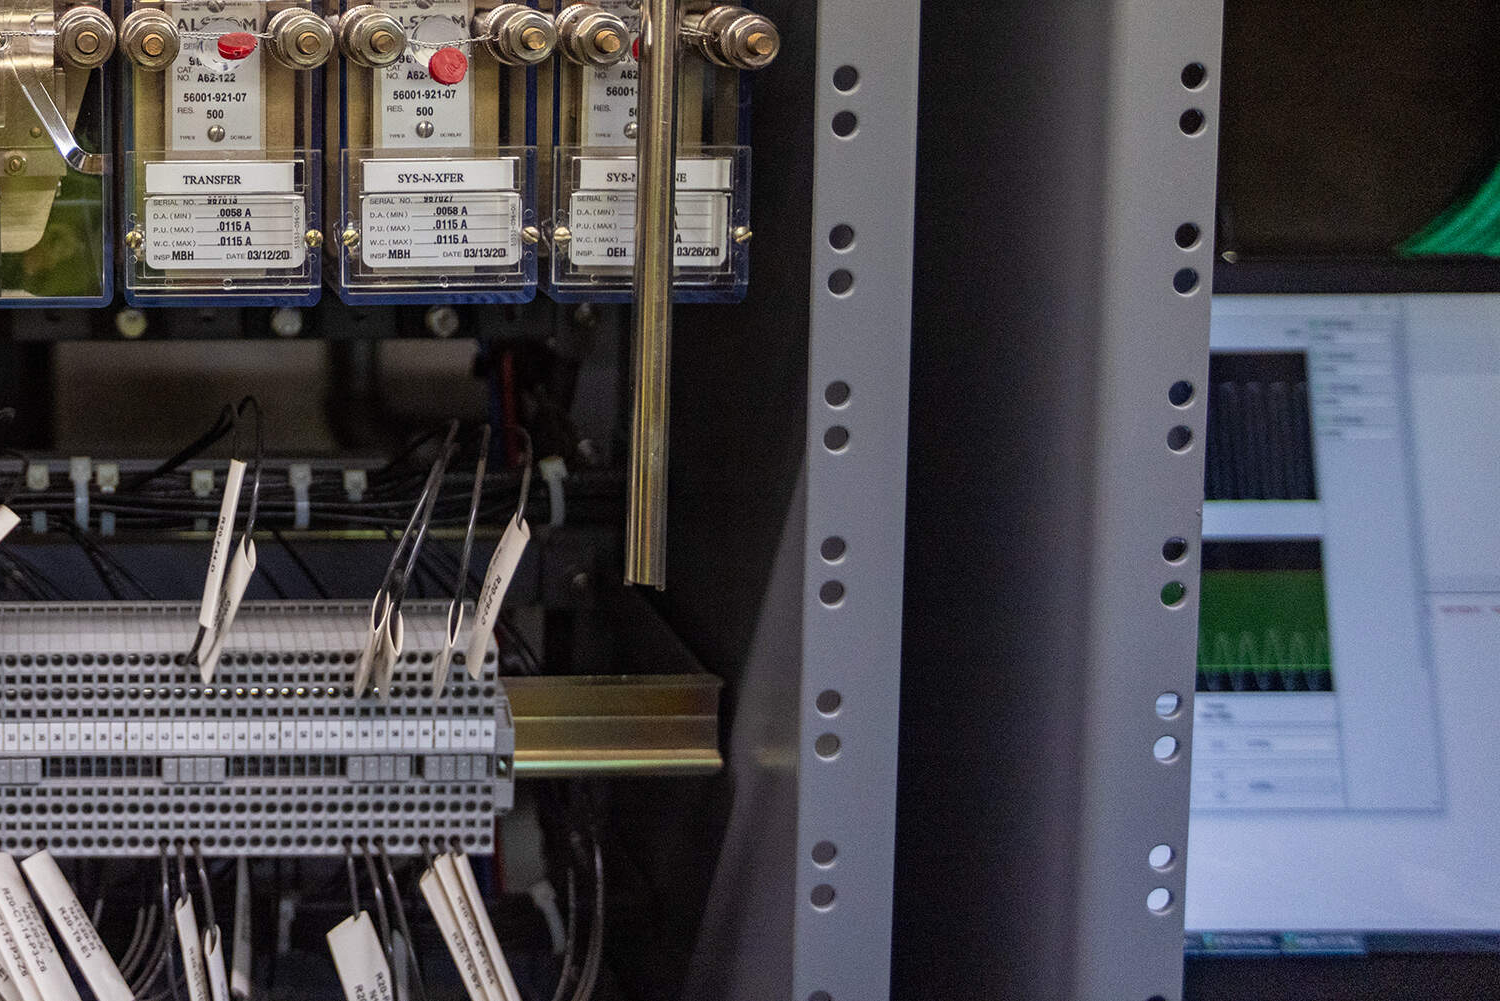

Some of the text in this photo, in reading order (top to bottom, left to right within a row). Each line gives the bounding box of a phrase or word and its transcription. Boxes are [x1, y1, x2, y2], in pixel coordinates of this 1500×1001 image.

[197, 73, 236, 83] A62-122
[183, 93, 247, 103] 56001-921-07
[392, 89, 457, 100] 56001-921-07
[206, 109, 224, 119] 500
[416, 107, 434, 116] 500
[183, 175, 242, 185] TRANSFER
[397, 173, 465, 184] SYS-N-XFER
[217, 208, 252, 218] .0058 A
[433, 206, 468, 216] .0058 A
[216, 221, 252, 232] .0115 A
[433, 219, 468, 230] .0115 A
[217, 237, 252, 246] .0115 A
[434, 234, 469, 245] .0115 A
[171, 250, 194, 261] MBH
[388, 249, 411, 259] MBH
[606, 247, 627, 257] OEH
